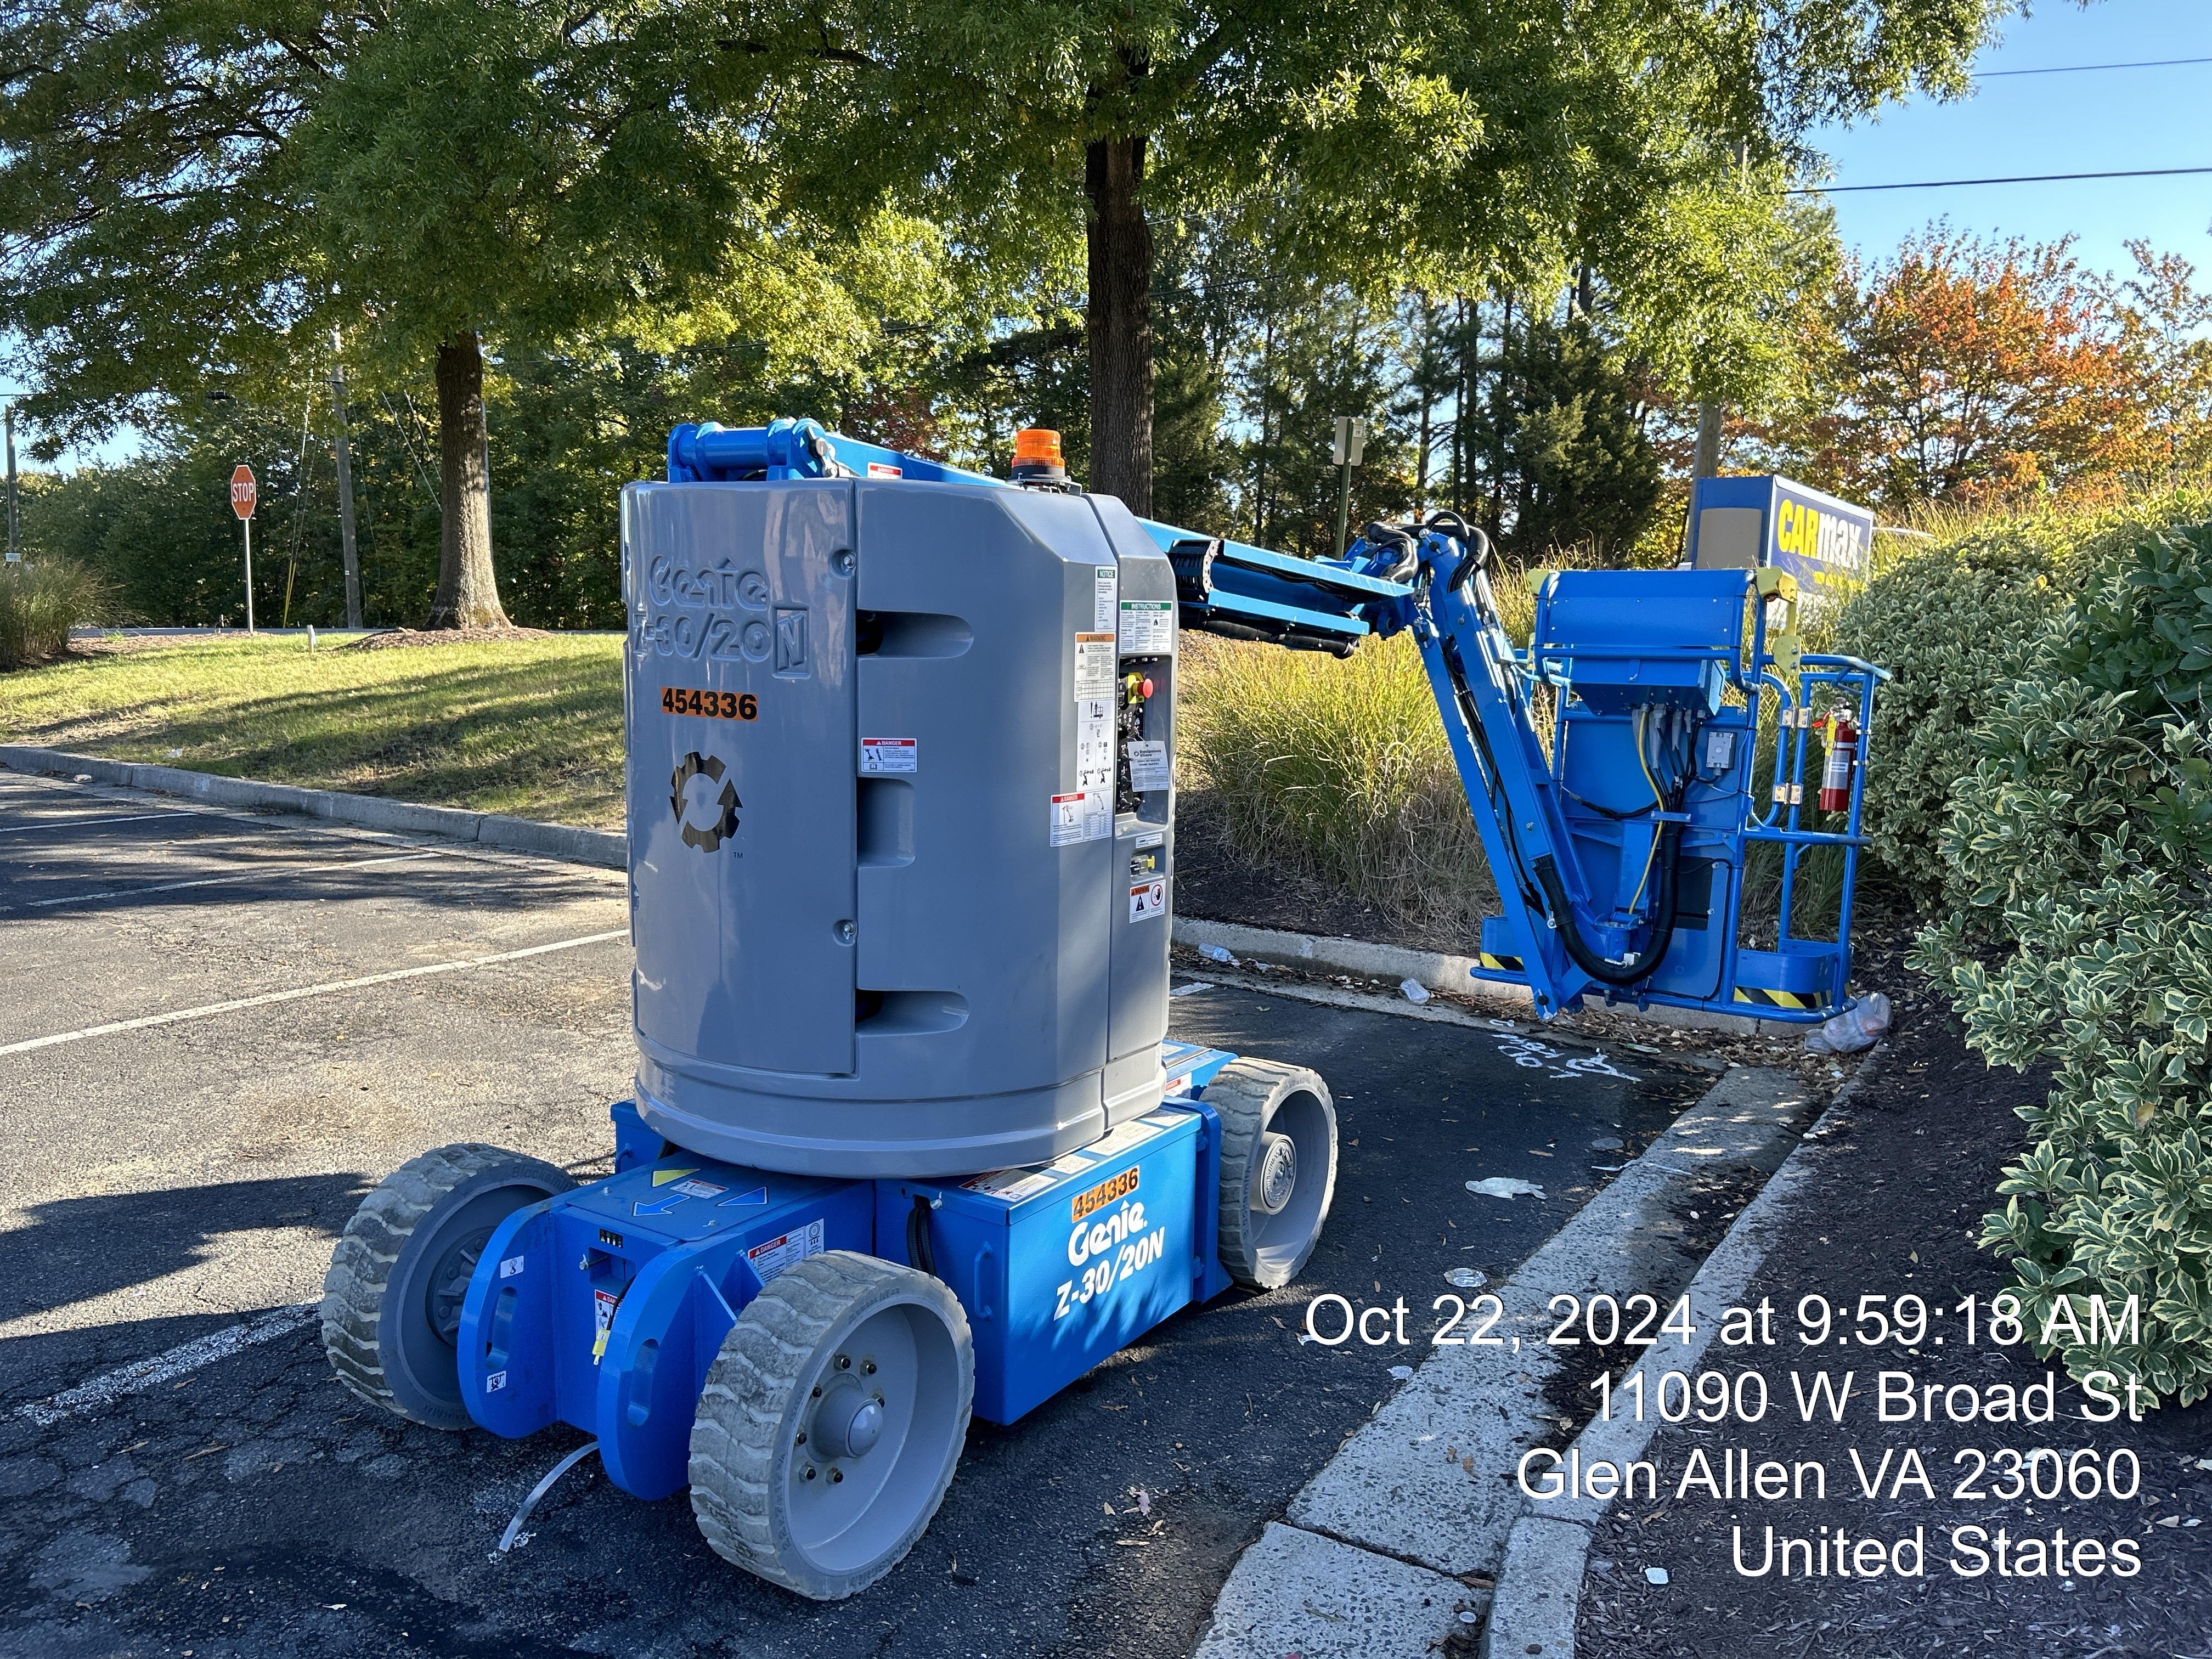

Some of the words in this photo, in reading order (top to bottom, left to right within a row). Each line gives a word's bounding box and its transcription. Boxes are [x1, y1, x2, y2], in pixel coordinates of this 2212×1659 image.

[233, 483, 254, 503] STOP
[650, 554, 770, 610] Genie
[662, 688, 758, 720] 454336
[1073, 1167, 1139, 1218] 454336
[760, 1239, 781, 1253] DANGER
[1068, 1200, 1147, 1266] Genie
[1053, 1226, 1165, 1322] Z-30/20N
